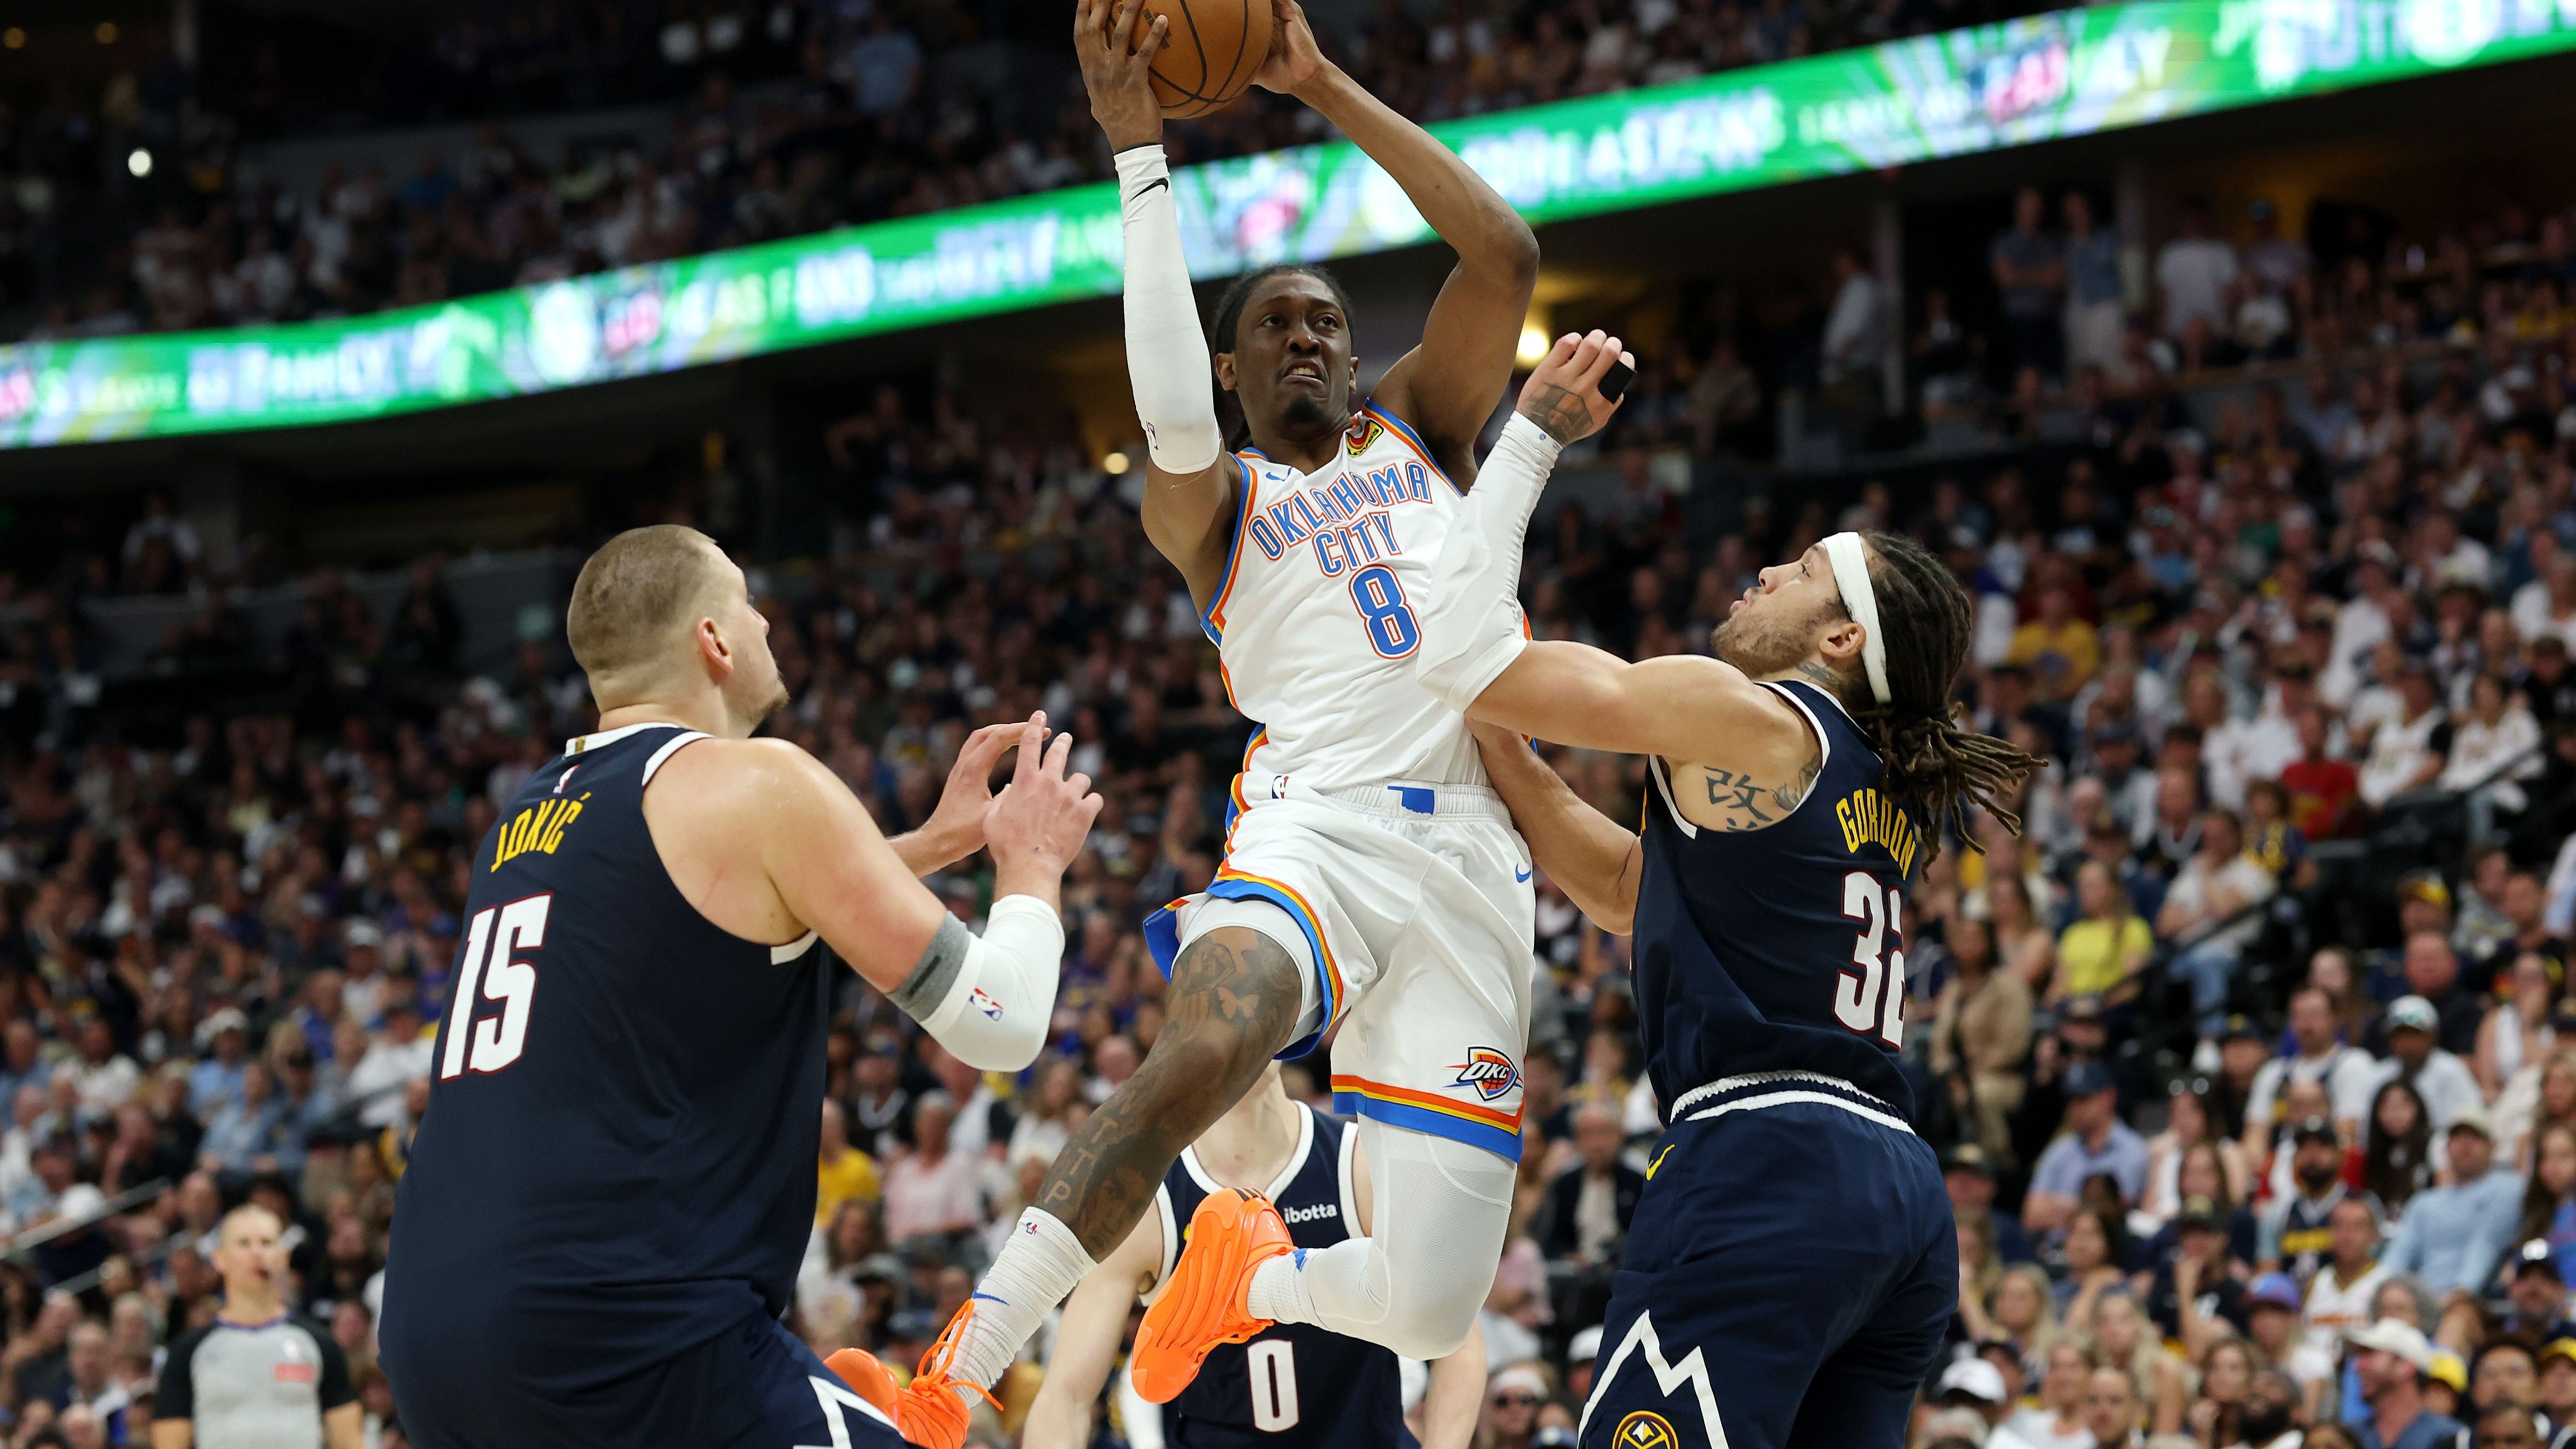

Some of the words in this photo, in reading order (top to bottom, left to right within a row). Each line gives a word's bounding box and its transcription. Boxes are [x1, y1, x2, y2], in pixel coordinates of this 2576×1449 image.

[1249, 461, 1433, 561] OKLAHOMA
[1312, 511, 1402, 578] CITY
[1348, 563, 1422, 659] 8
[491, 792, 592, 873] JOKIĆ
[1836, 788, 1916, 881] GORDON
[440, 891, 554, 1083] 15
[1457, 1060, 1511, 1082] OKC
[1283, 1203, 1337, 1224] ibotta
[1246, 1338, 1299, 1433] 0
